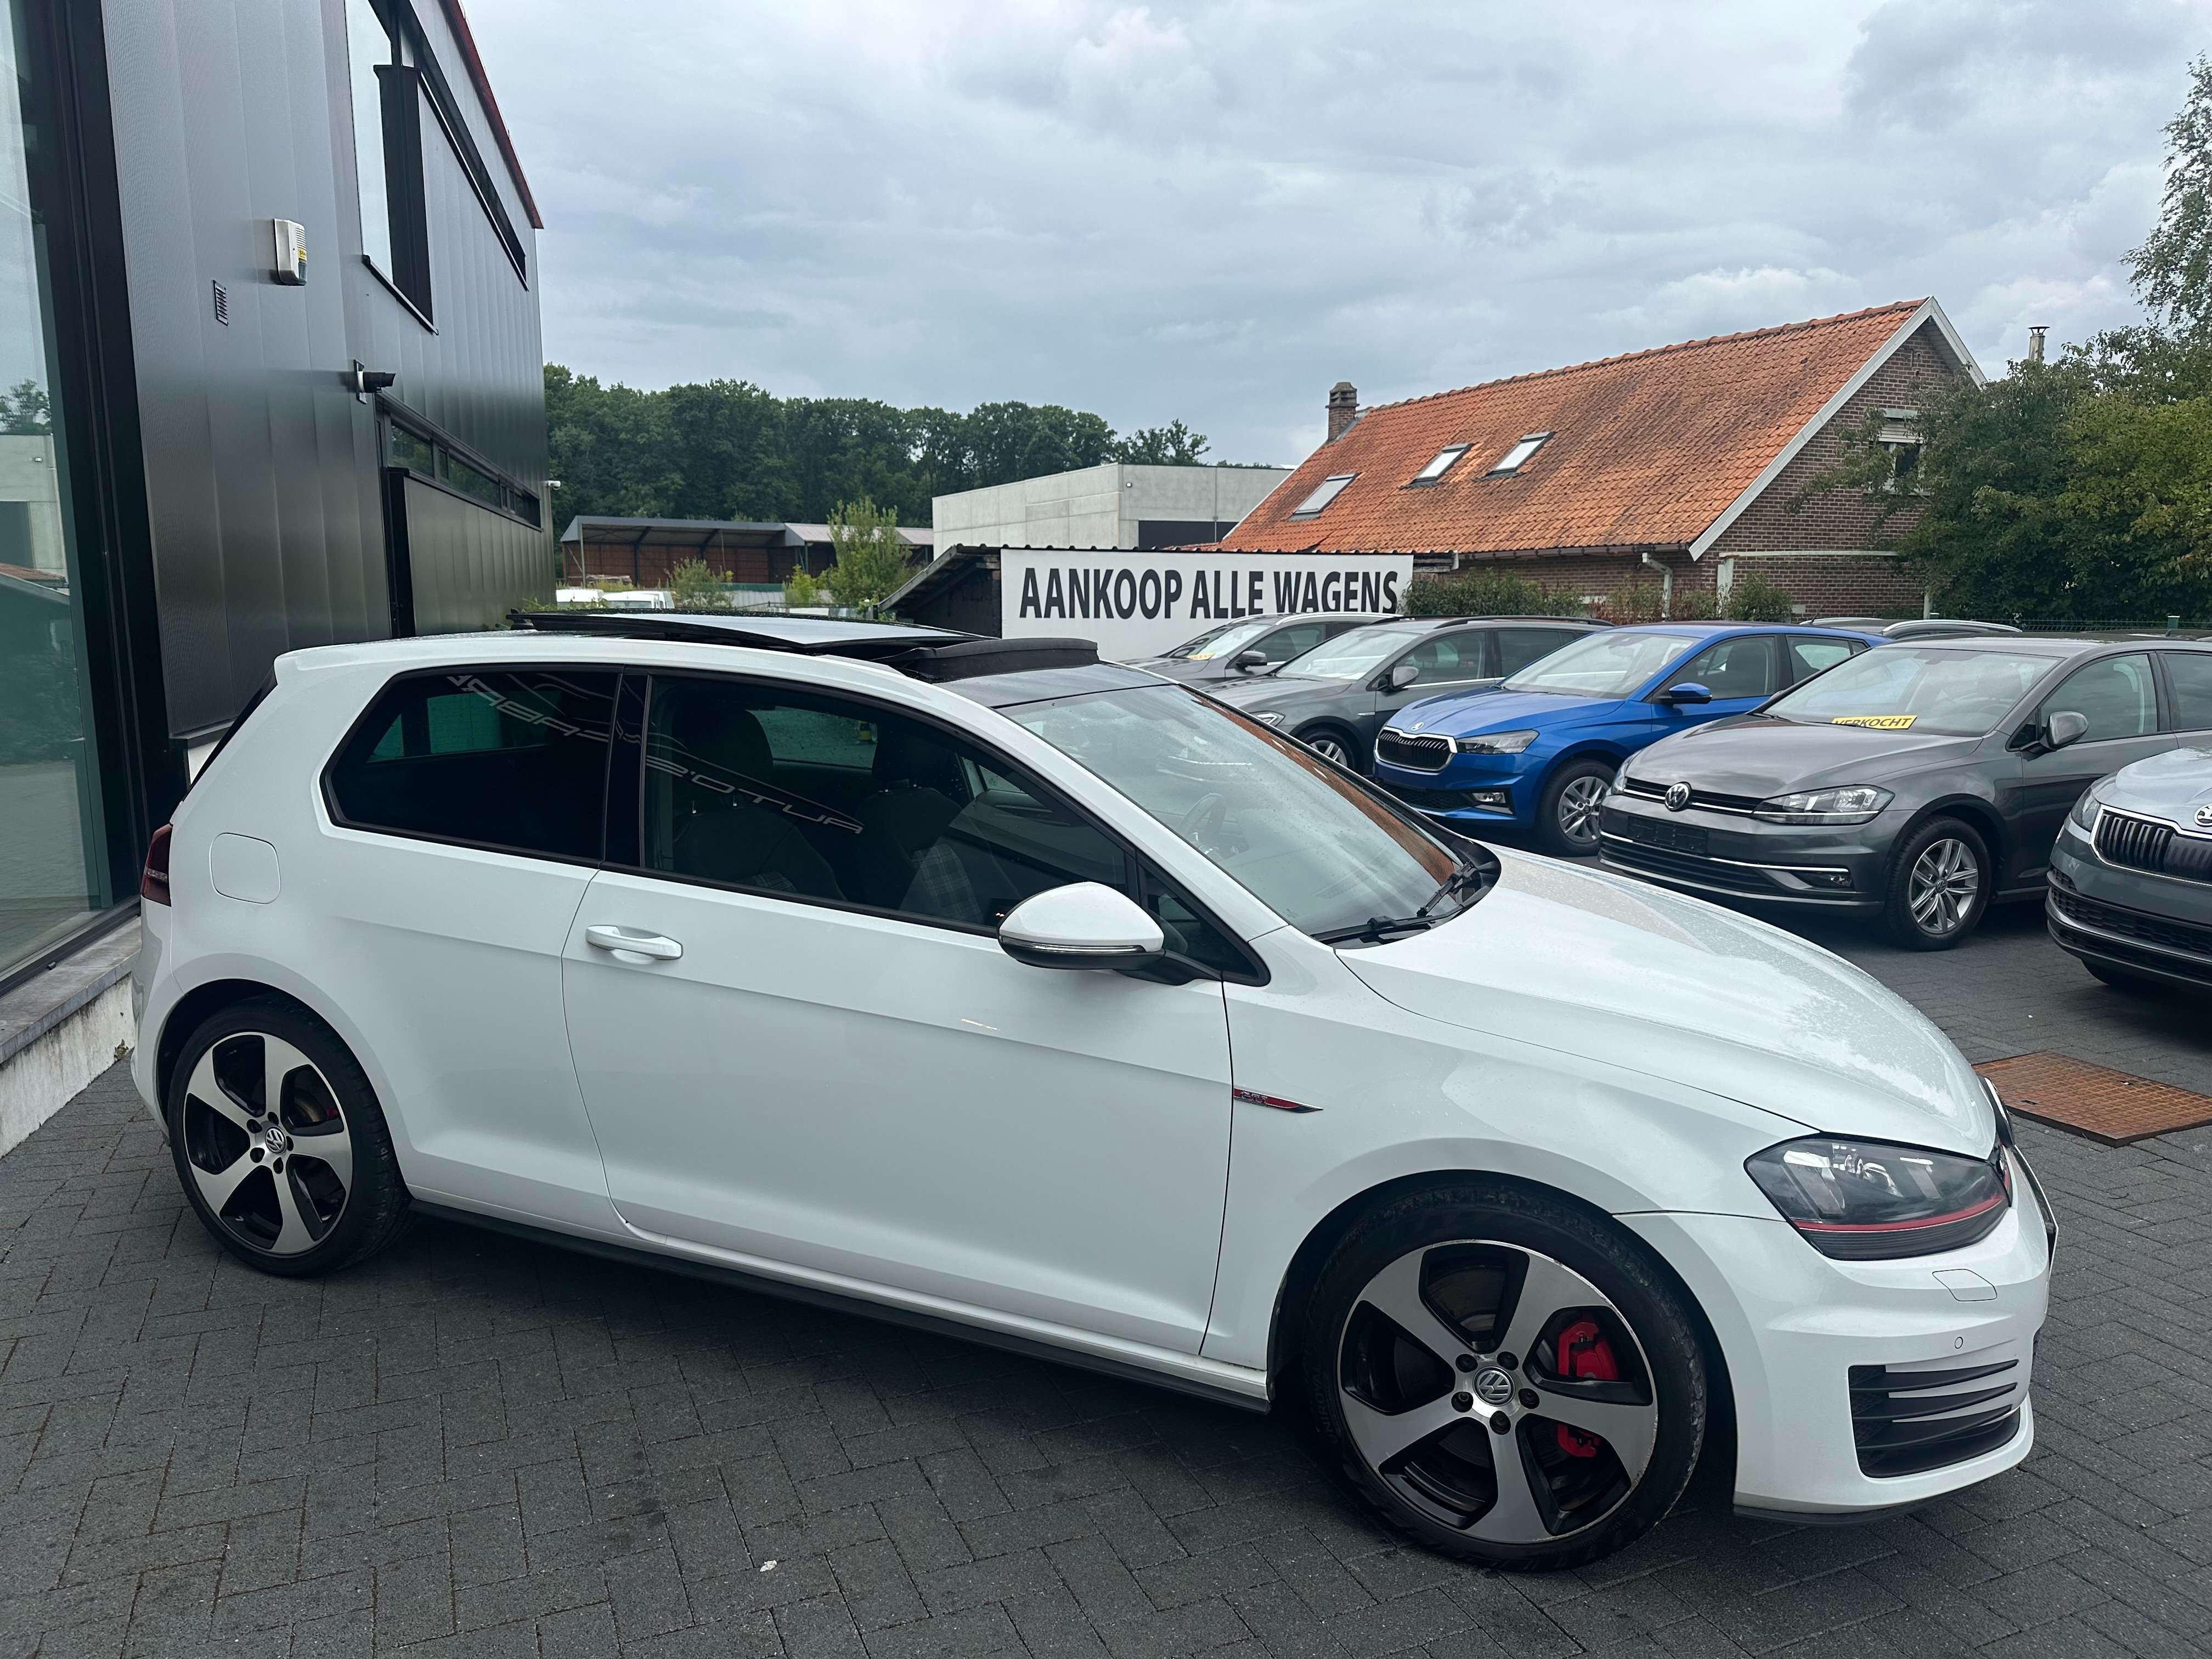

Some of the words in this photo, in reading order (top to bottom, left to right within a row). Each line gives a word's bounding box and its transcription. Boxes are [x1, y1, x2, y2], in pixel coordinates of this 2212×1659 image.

[1019, 568, 1182, 620] AANKOOP
[1190, 571, 1263, 619] ALLE
[1274, 571, 1398, 614] WAGENS
